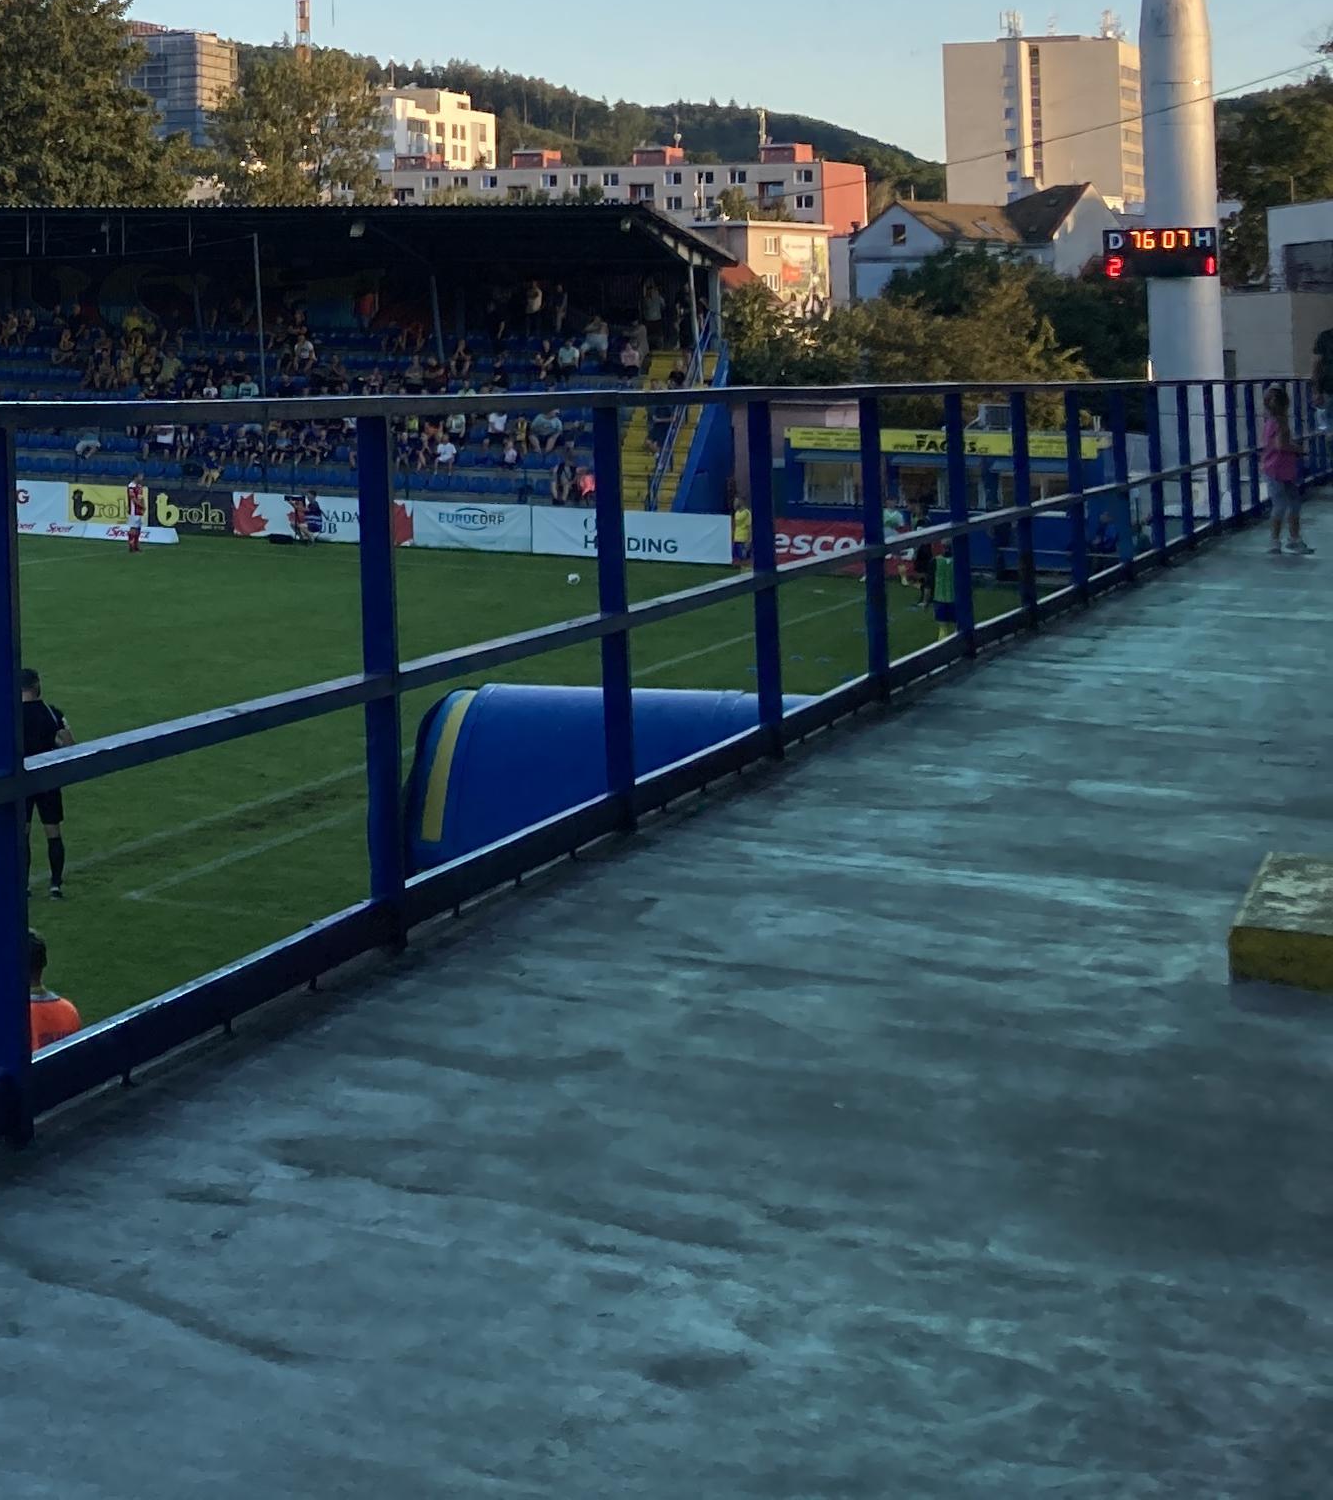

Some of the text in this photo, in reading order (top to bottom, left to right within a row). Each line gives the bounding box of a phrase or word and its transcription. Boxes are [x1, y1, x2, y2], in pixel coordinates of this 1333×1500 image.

[1109, 233, 1124, 249] D
[1194, 230, 1211, 248] H
[1107, 256, 1215, 277] 2 1
[155, 493, 226, 527] brola
[438, 513, 505, 525] EUROCORP
